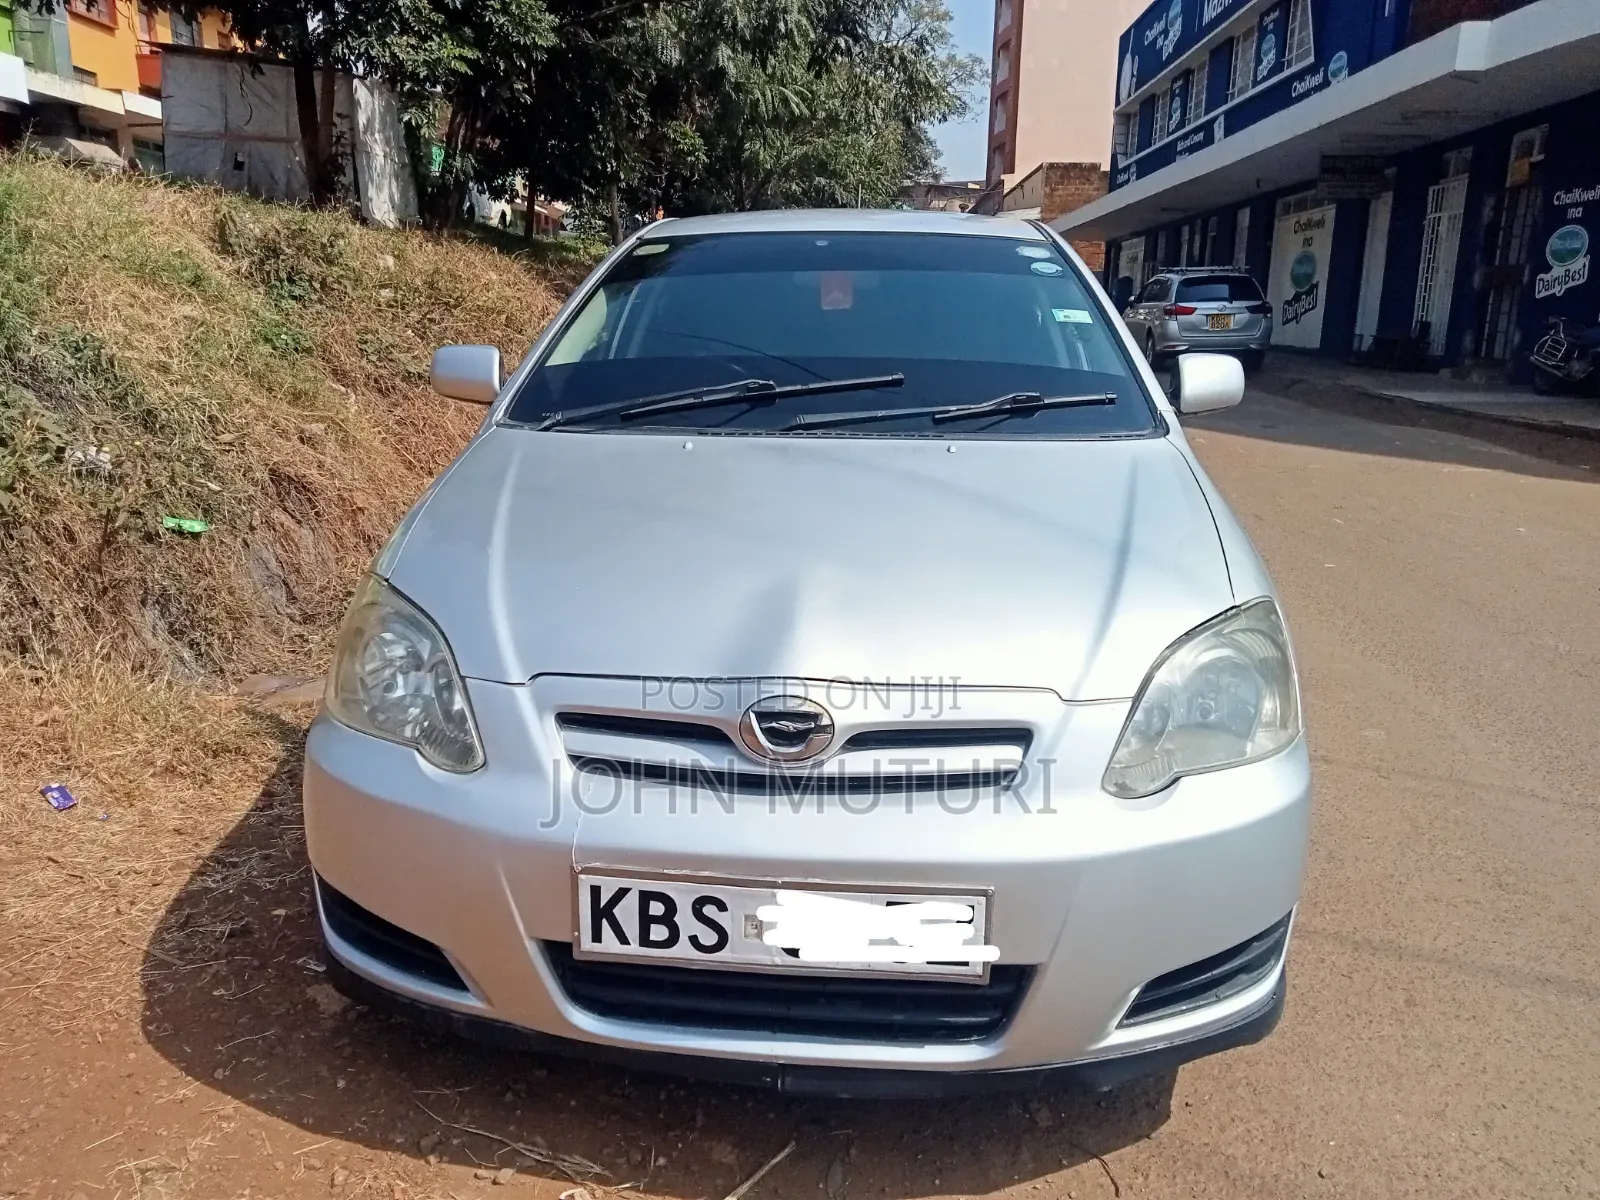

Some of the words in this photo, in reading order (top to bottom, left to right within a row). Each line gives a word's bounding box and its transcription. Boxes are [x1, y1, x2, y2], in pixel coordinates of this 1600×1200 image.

[1537, 261, 1587, 295] DairyBest
[1283, 287, 1317, 322] DairyBest
[589, 884, 730, 955] KBS
